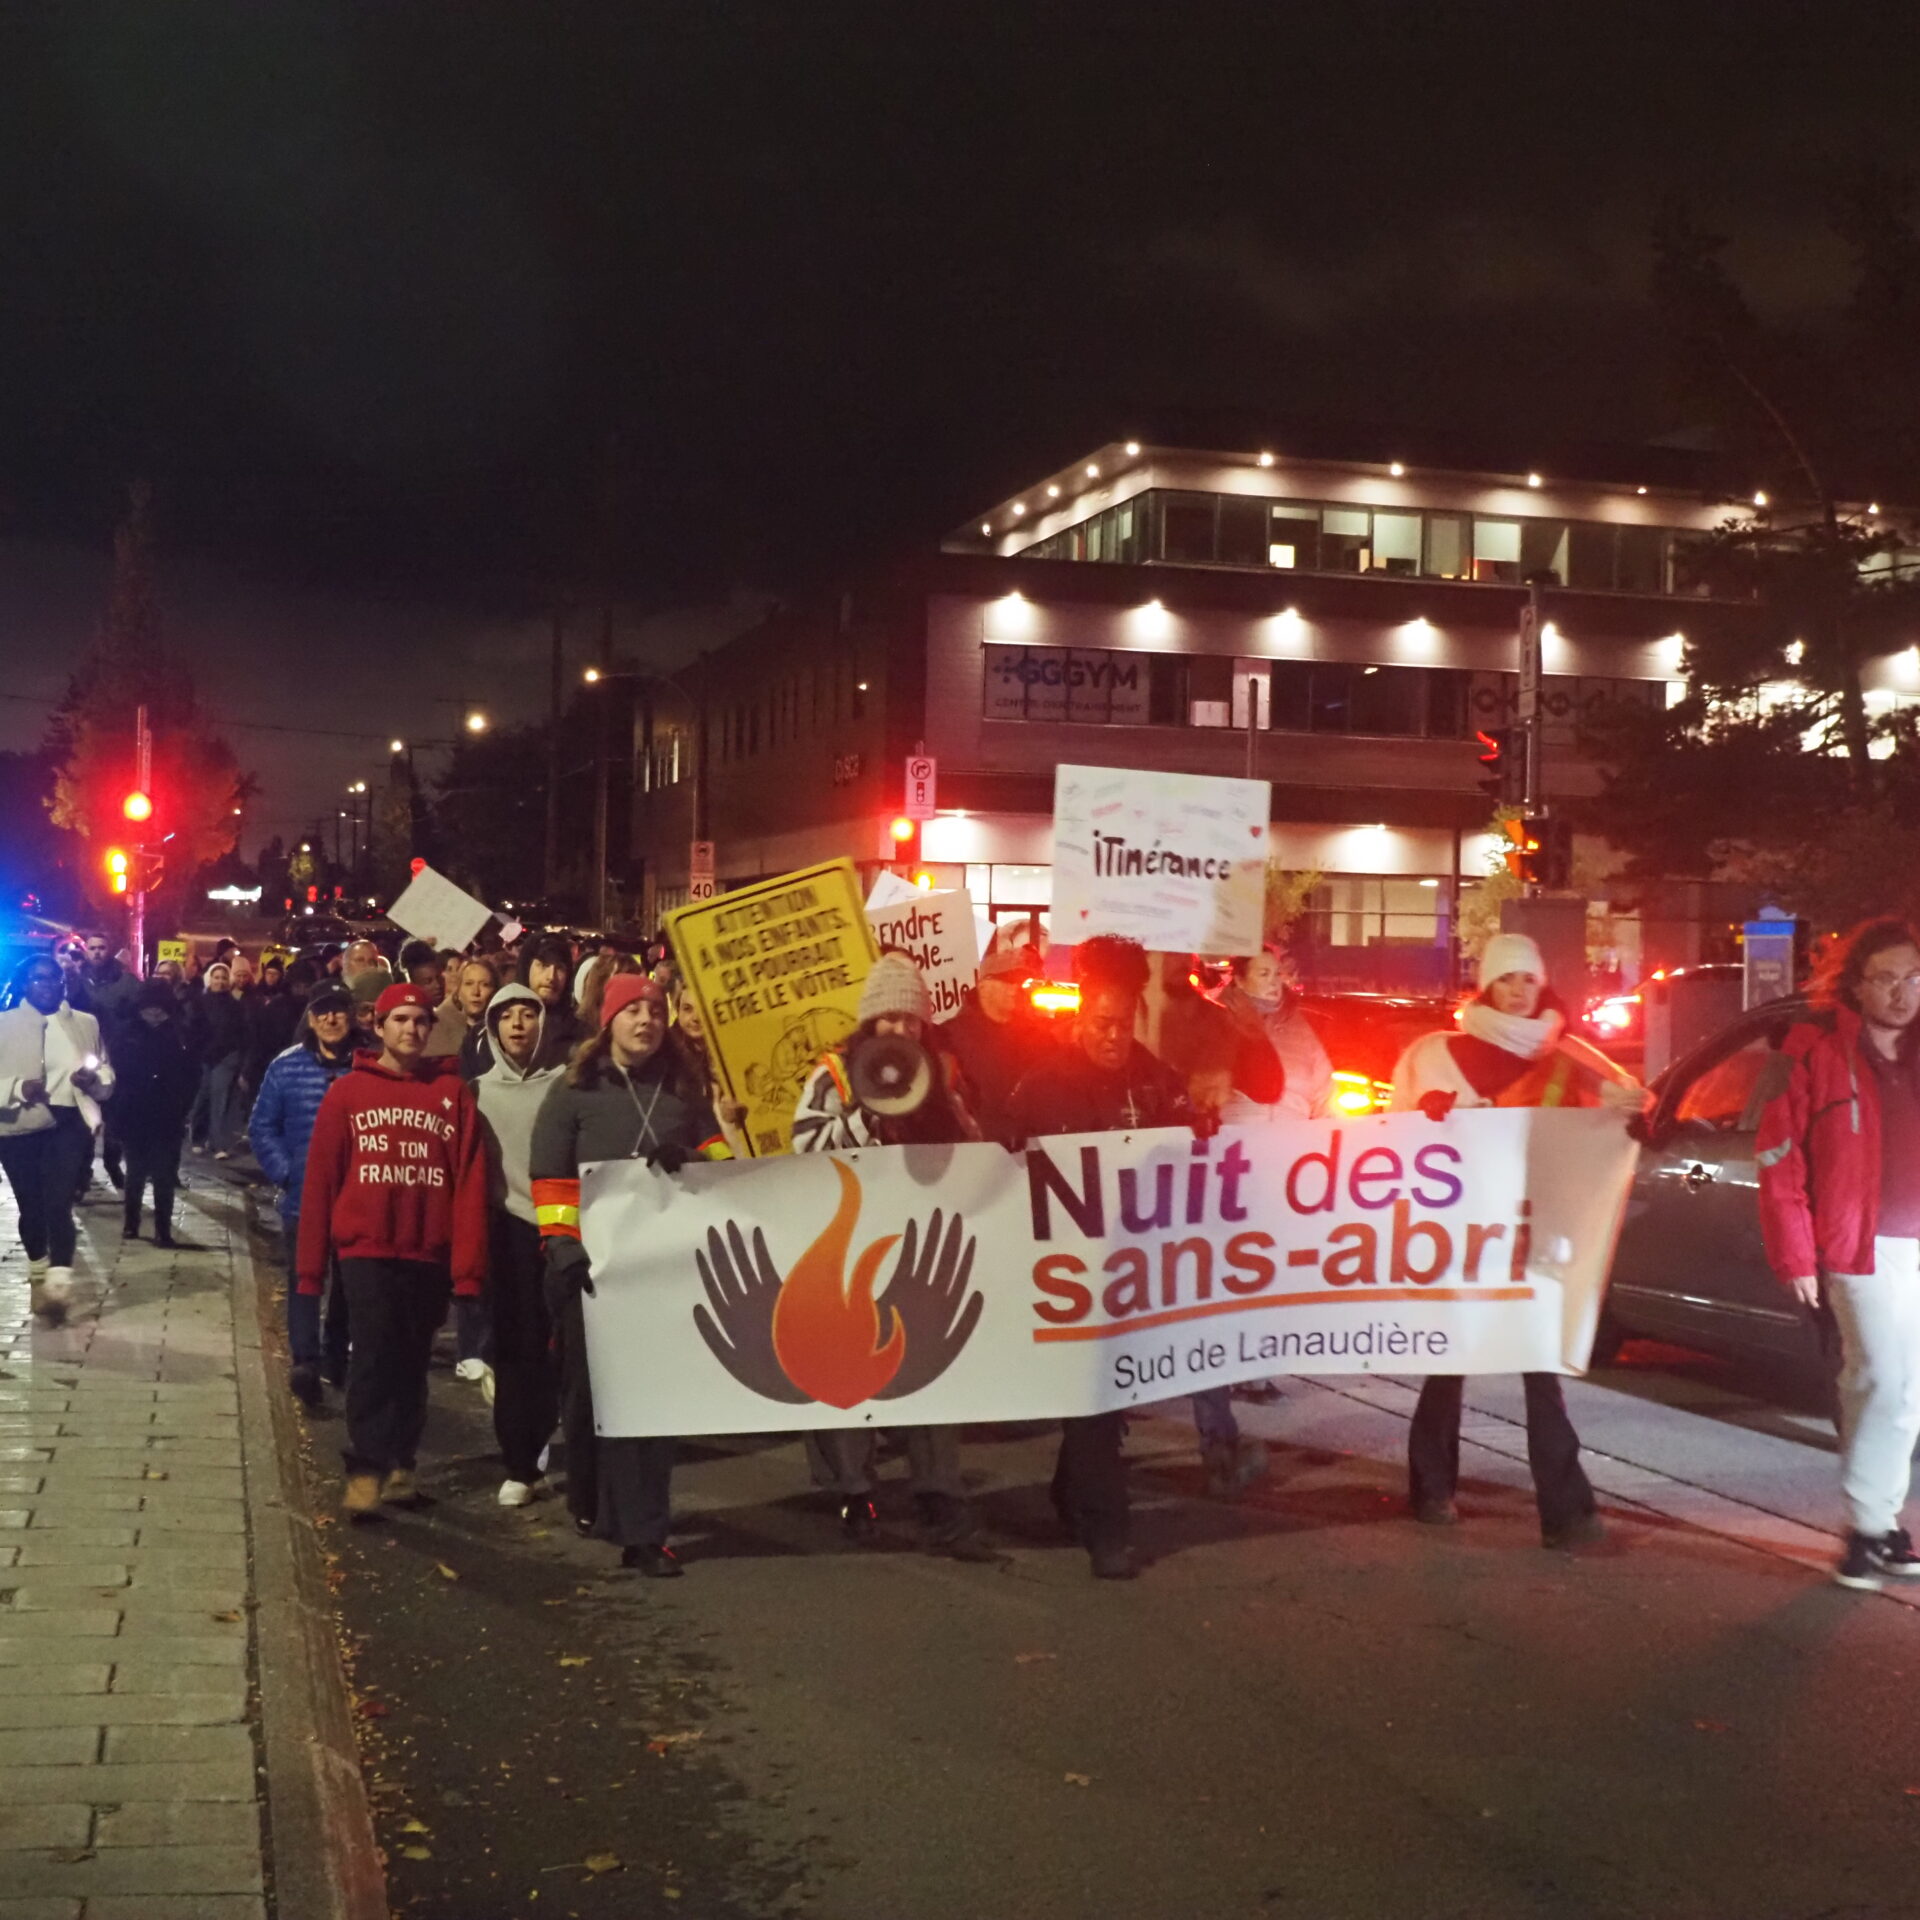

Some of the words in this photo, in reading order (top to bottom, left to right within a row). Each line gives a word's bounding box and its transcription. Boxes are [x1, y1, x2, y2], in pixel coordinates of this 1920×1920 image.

[692, 883, 712, 899] 40
[715, 886, 818, 934] ATTENTION
[715, 935, 757, 966] NOS
[750, 936, 843, 985] POURRAIT
[712, 991, 763, 1025] ÊTRE
[763, 983, 789, 1009] LE
[359, 1134, 389, 1152] PAS
[398, 1141, 428, 1159] TON
[359, 1164, 445, 1187] FRANÇAIS
[1026, 1137, 1254, 1241] Nuit
[1285, 1129, 1463, 1216] des
[1031, 1199, 1533, 1325] sans-abri
[1114, 1346, 1175, 1389] Sud
[1187, 1340, 1226, 1370] de
[1238, 1322, 1450, 1364] Lanaudière
